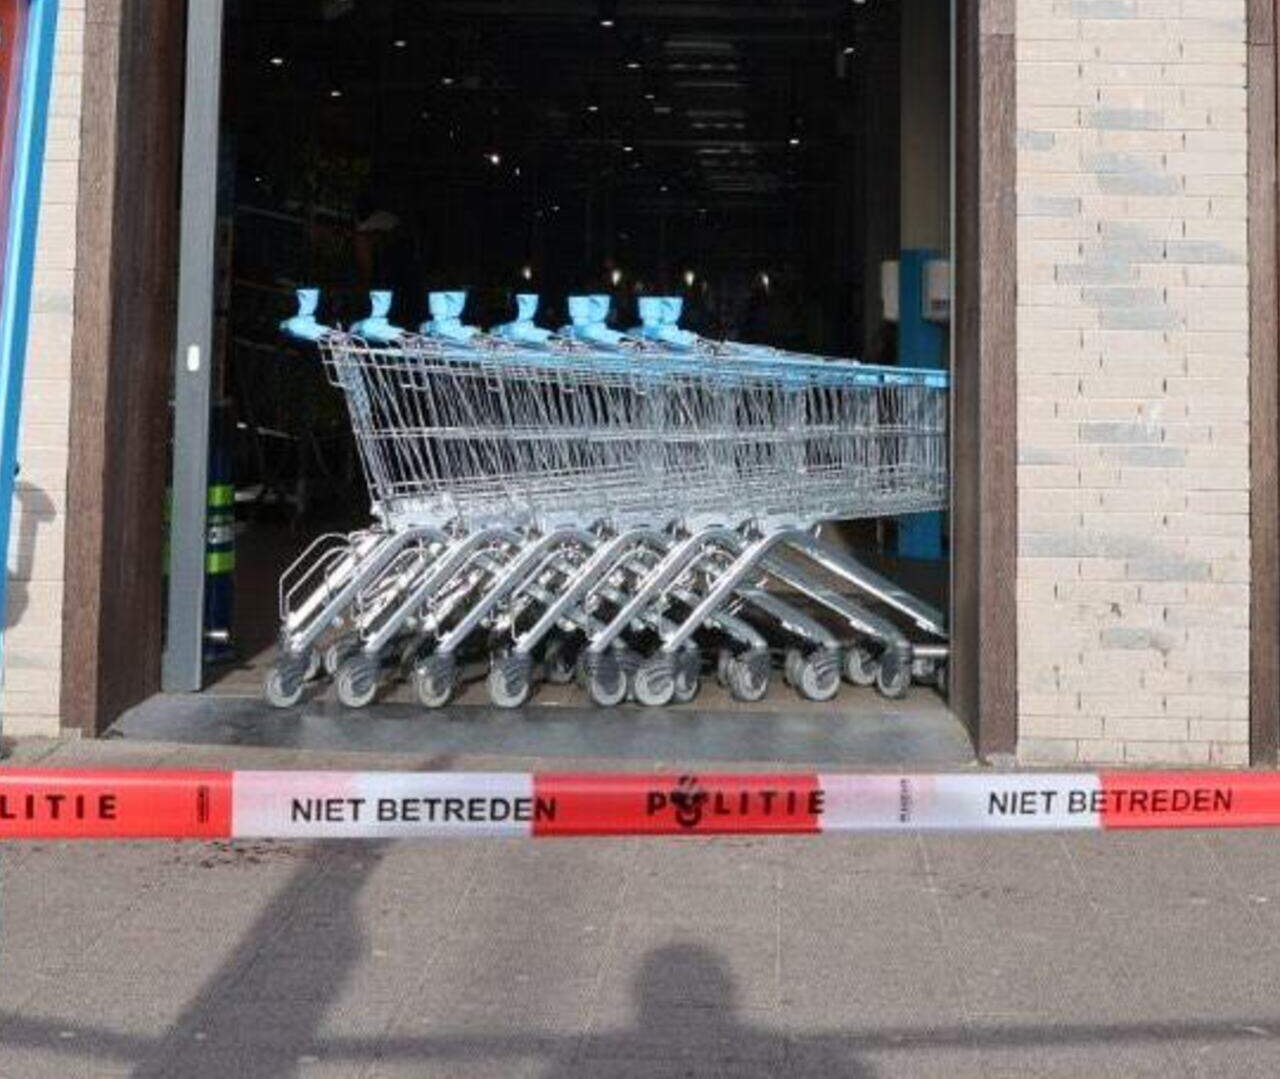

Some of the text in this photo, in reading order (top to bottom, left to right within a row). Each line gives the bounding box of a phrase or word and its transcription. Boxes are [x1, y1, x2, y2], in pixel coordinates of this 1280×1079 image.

[291, 797, 558, 822] NIET BETREDEN
[987, 787, 1234, 815] NIET BETREDEN
